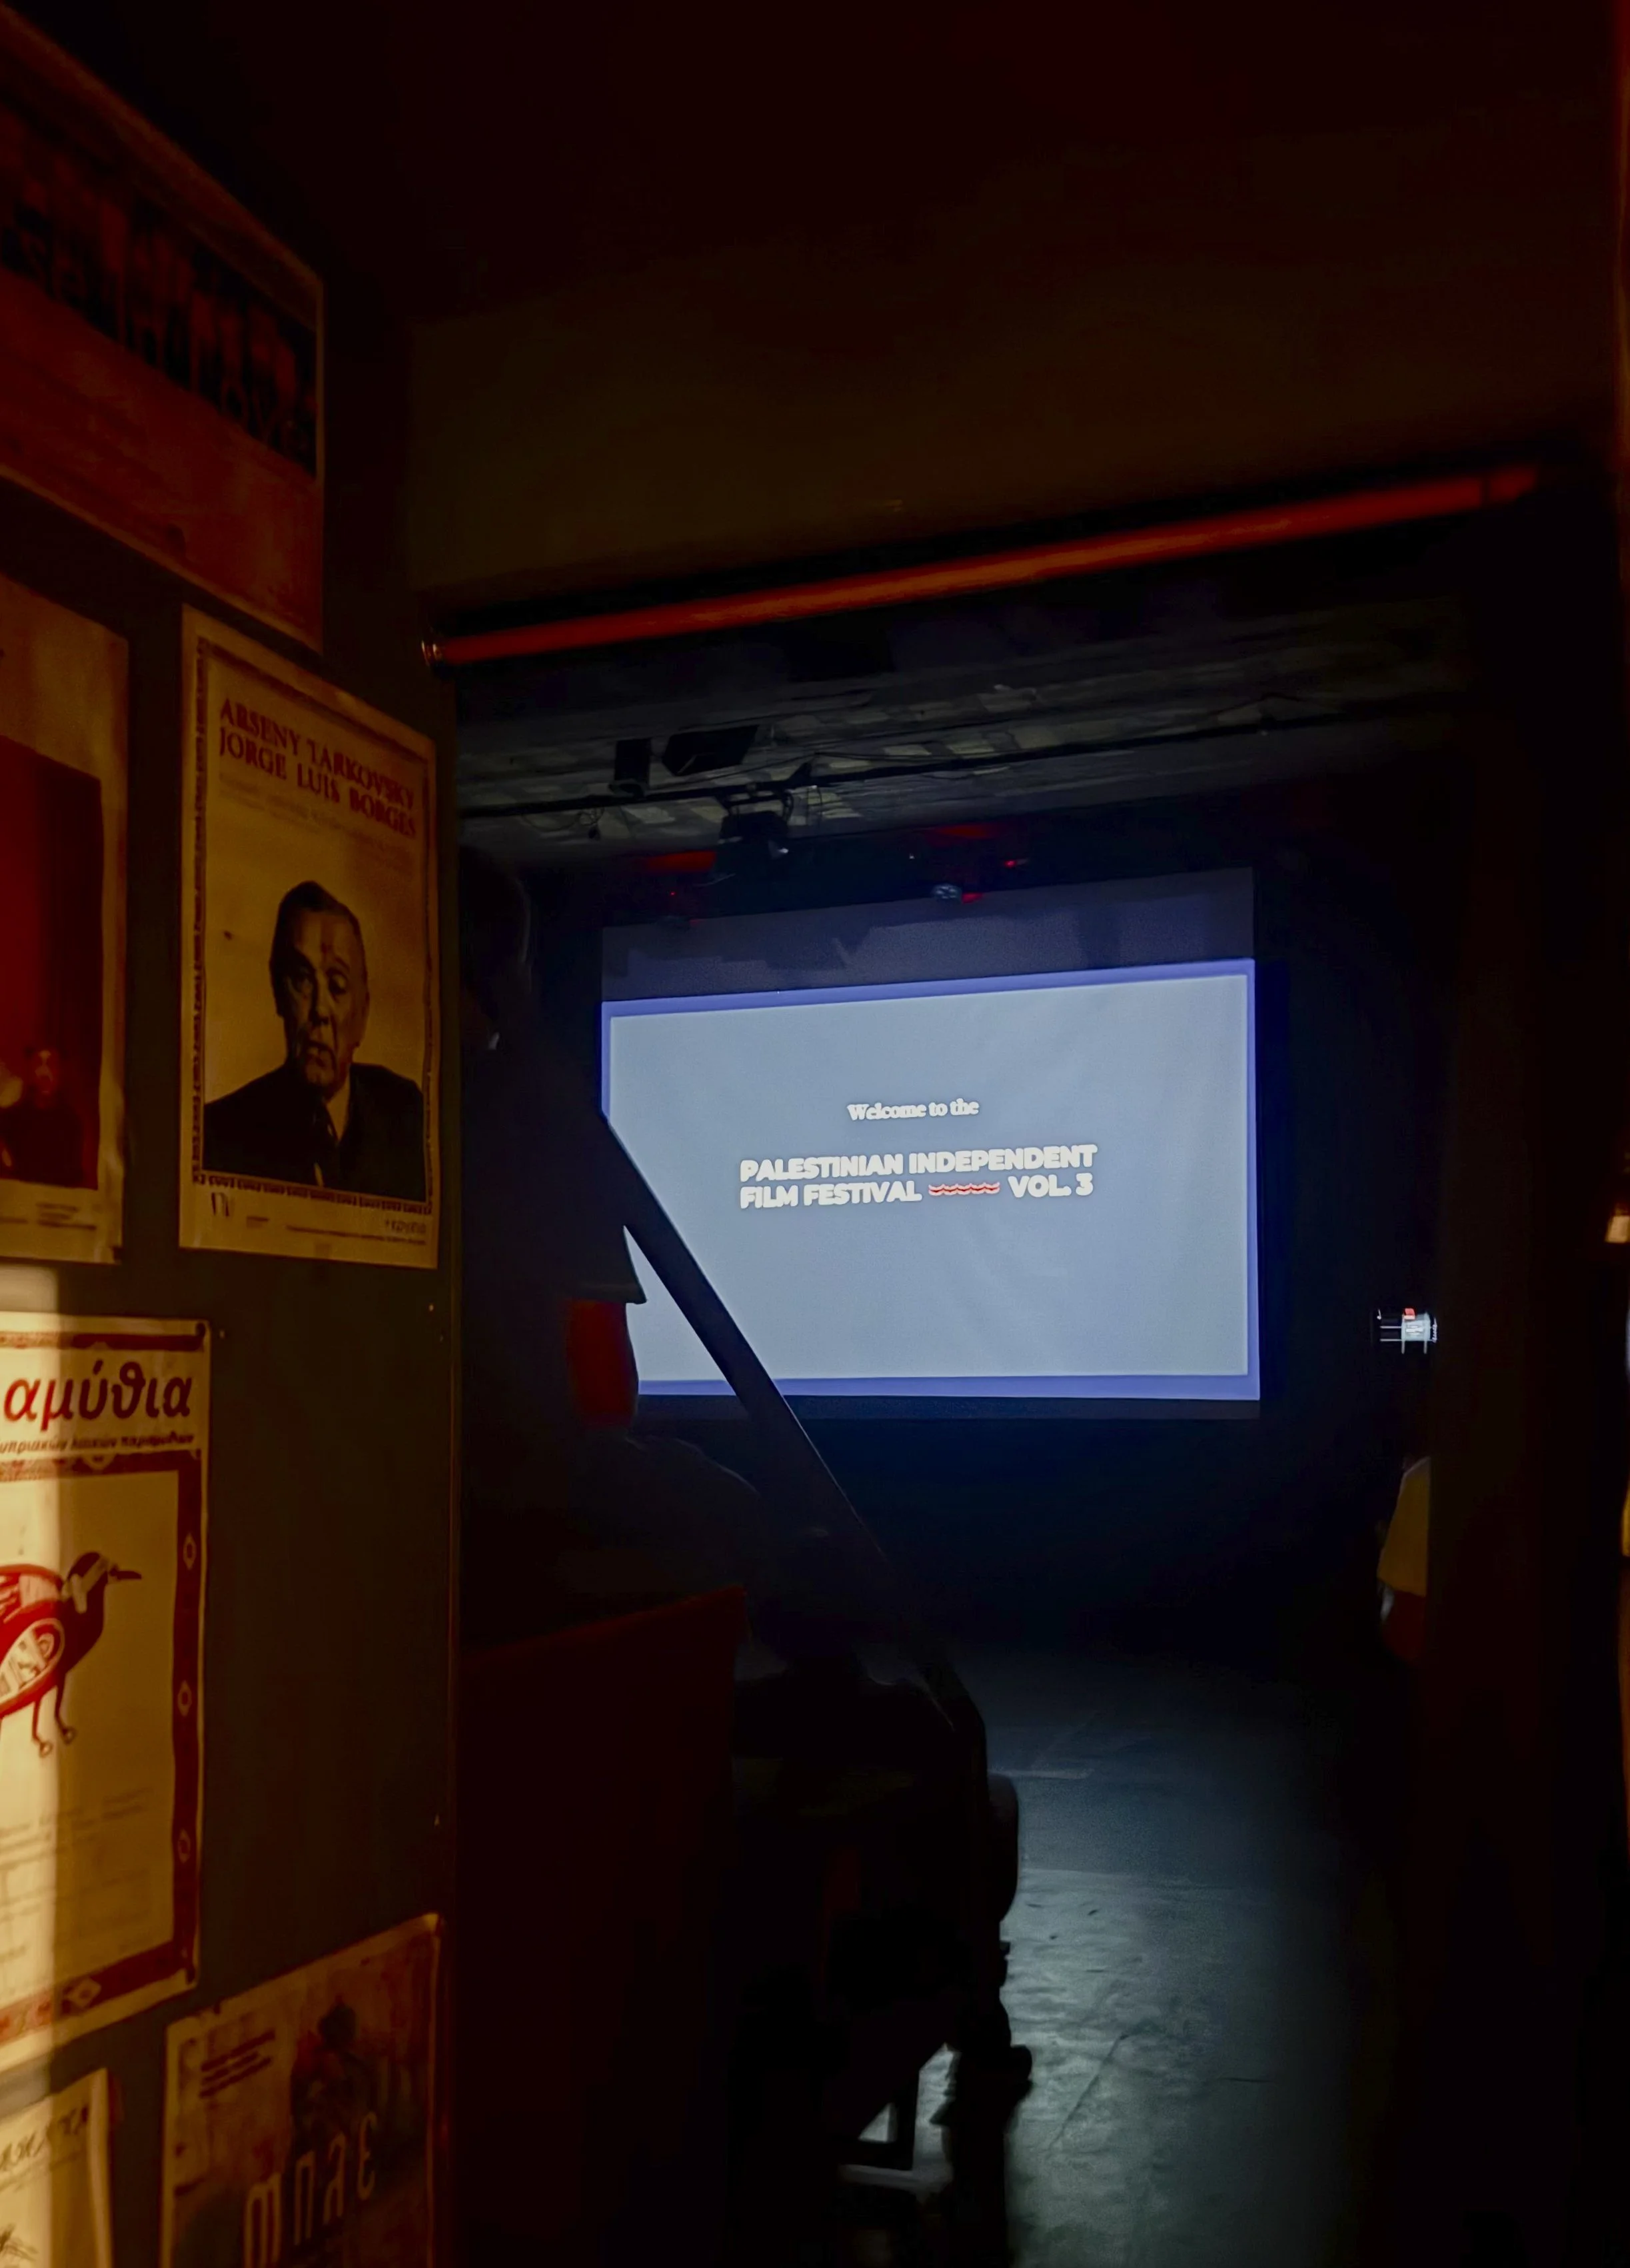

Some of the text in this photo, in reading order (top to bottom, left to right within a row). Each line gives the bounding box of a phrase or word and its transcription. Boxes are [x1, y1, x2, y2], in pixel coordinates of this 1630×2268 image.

[220, 727, 287, 780] JORGE
[297, 763, 340, 802] LUIS
[847, 1098, 979, 1120] Welcome to the
[740, 1144, 1098, 1182] PALESTINIAN INDEPENDENT
[740, 1172, 1094, 1209] FILM FESTIVAL VOL. 3
[3, 1359, 192, 1432] αμύθια
